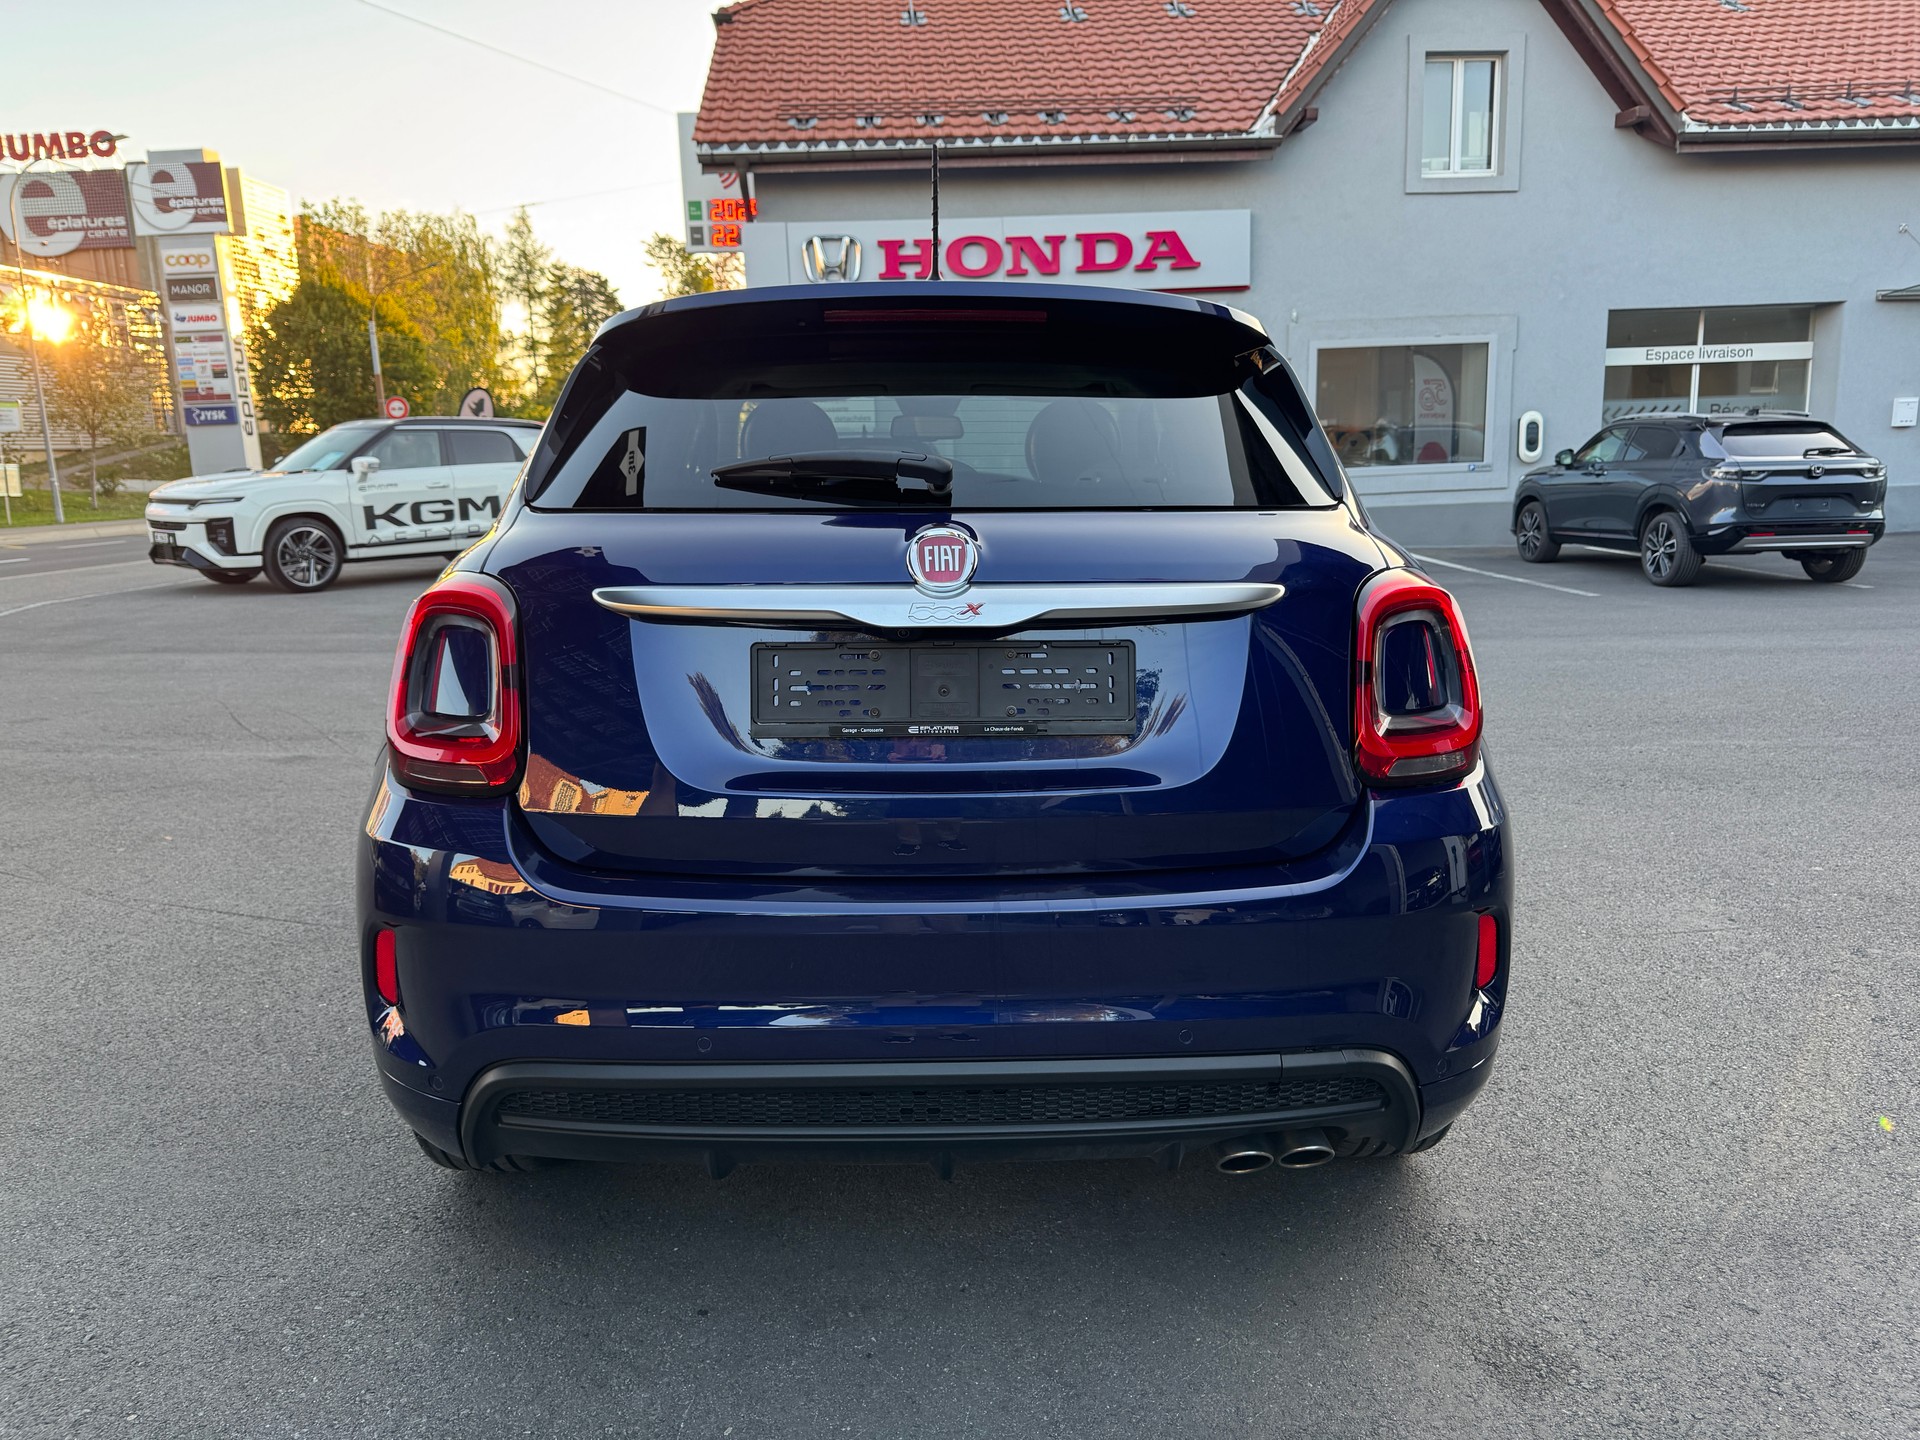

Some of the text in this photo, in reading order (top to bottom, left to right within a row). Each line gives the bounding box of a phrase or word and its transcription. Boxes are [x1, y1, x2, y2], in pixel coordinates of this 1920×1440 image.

[168, 196, 224, 208] éplatures
[47, 215, 126, 231] éplatures
[87, 228, 129, 239] centre
[165, 254, 210, 269] coop
[877, 230, 1201, 280] HONDA
[171, 283, 211, 295] MANOR
[187, 314, 217, 323] JUMBO
[1645, 346, 1754, 362] Espace livraison
[233, 334, 254, 436] éplatur
[199, 409, 228, 421] JYSK
[363, 495, 501, 530] KGM
[923, 545, 962, 572] FIAT
